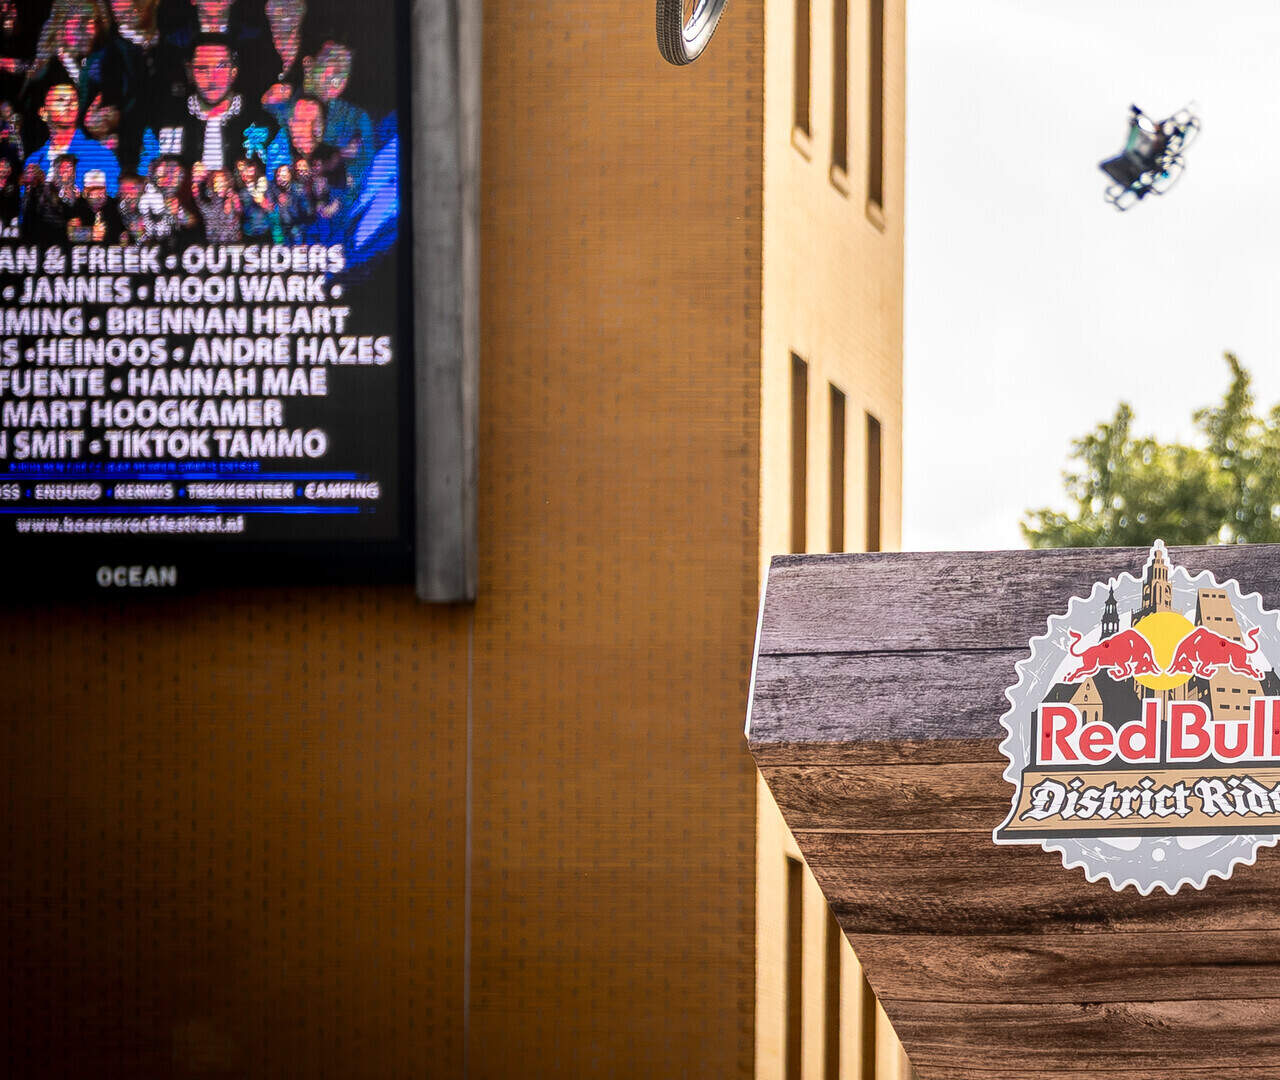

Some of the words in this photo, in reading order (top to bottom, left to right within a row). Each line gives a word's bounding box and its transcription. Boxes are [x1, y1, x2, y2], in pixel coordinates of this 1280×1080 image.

[43, 245, 66, 275] &
[71, 245, 161, 274] FREEK
[181, 244, 346, 274] OUTSIDERS
[19, 276, 132, 304] JANNES
[154, 275, 236, 305] MOOI
[238, 275, 326, 303] WARK
[106, 307, 248, 336] BRENNAN
[252, 306, 350, 336] HEART
[189, 333, 290, 365] ANDRÉ
[296, 336, 393, 365] HAZES
[0, 368, 105, 397] FUENTE
[127, 368, 257, 396] HANNAH
[261, 367, 328, 396] MAE
[2, 400, 87, 428] MART
[91, 399, 283, 428] HOOGKAMER
[13, 430, 85, 460] SMIT
[104, 430, 210, 459] TIKTOK
[212, 429, 328, 459] TAMMO
[34, 483, 102, 500] ENDURO
[113, 483, 174, 500] KERMIS
[187, 482, 294, 500] TREKKERTREK
[304, 482, 380, 499] CAMPING
[97, 567, 177, 586] OCEAN
[1040, 701, 1159, 763] Red
[1020, 777, 1193, 820] District
